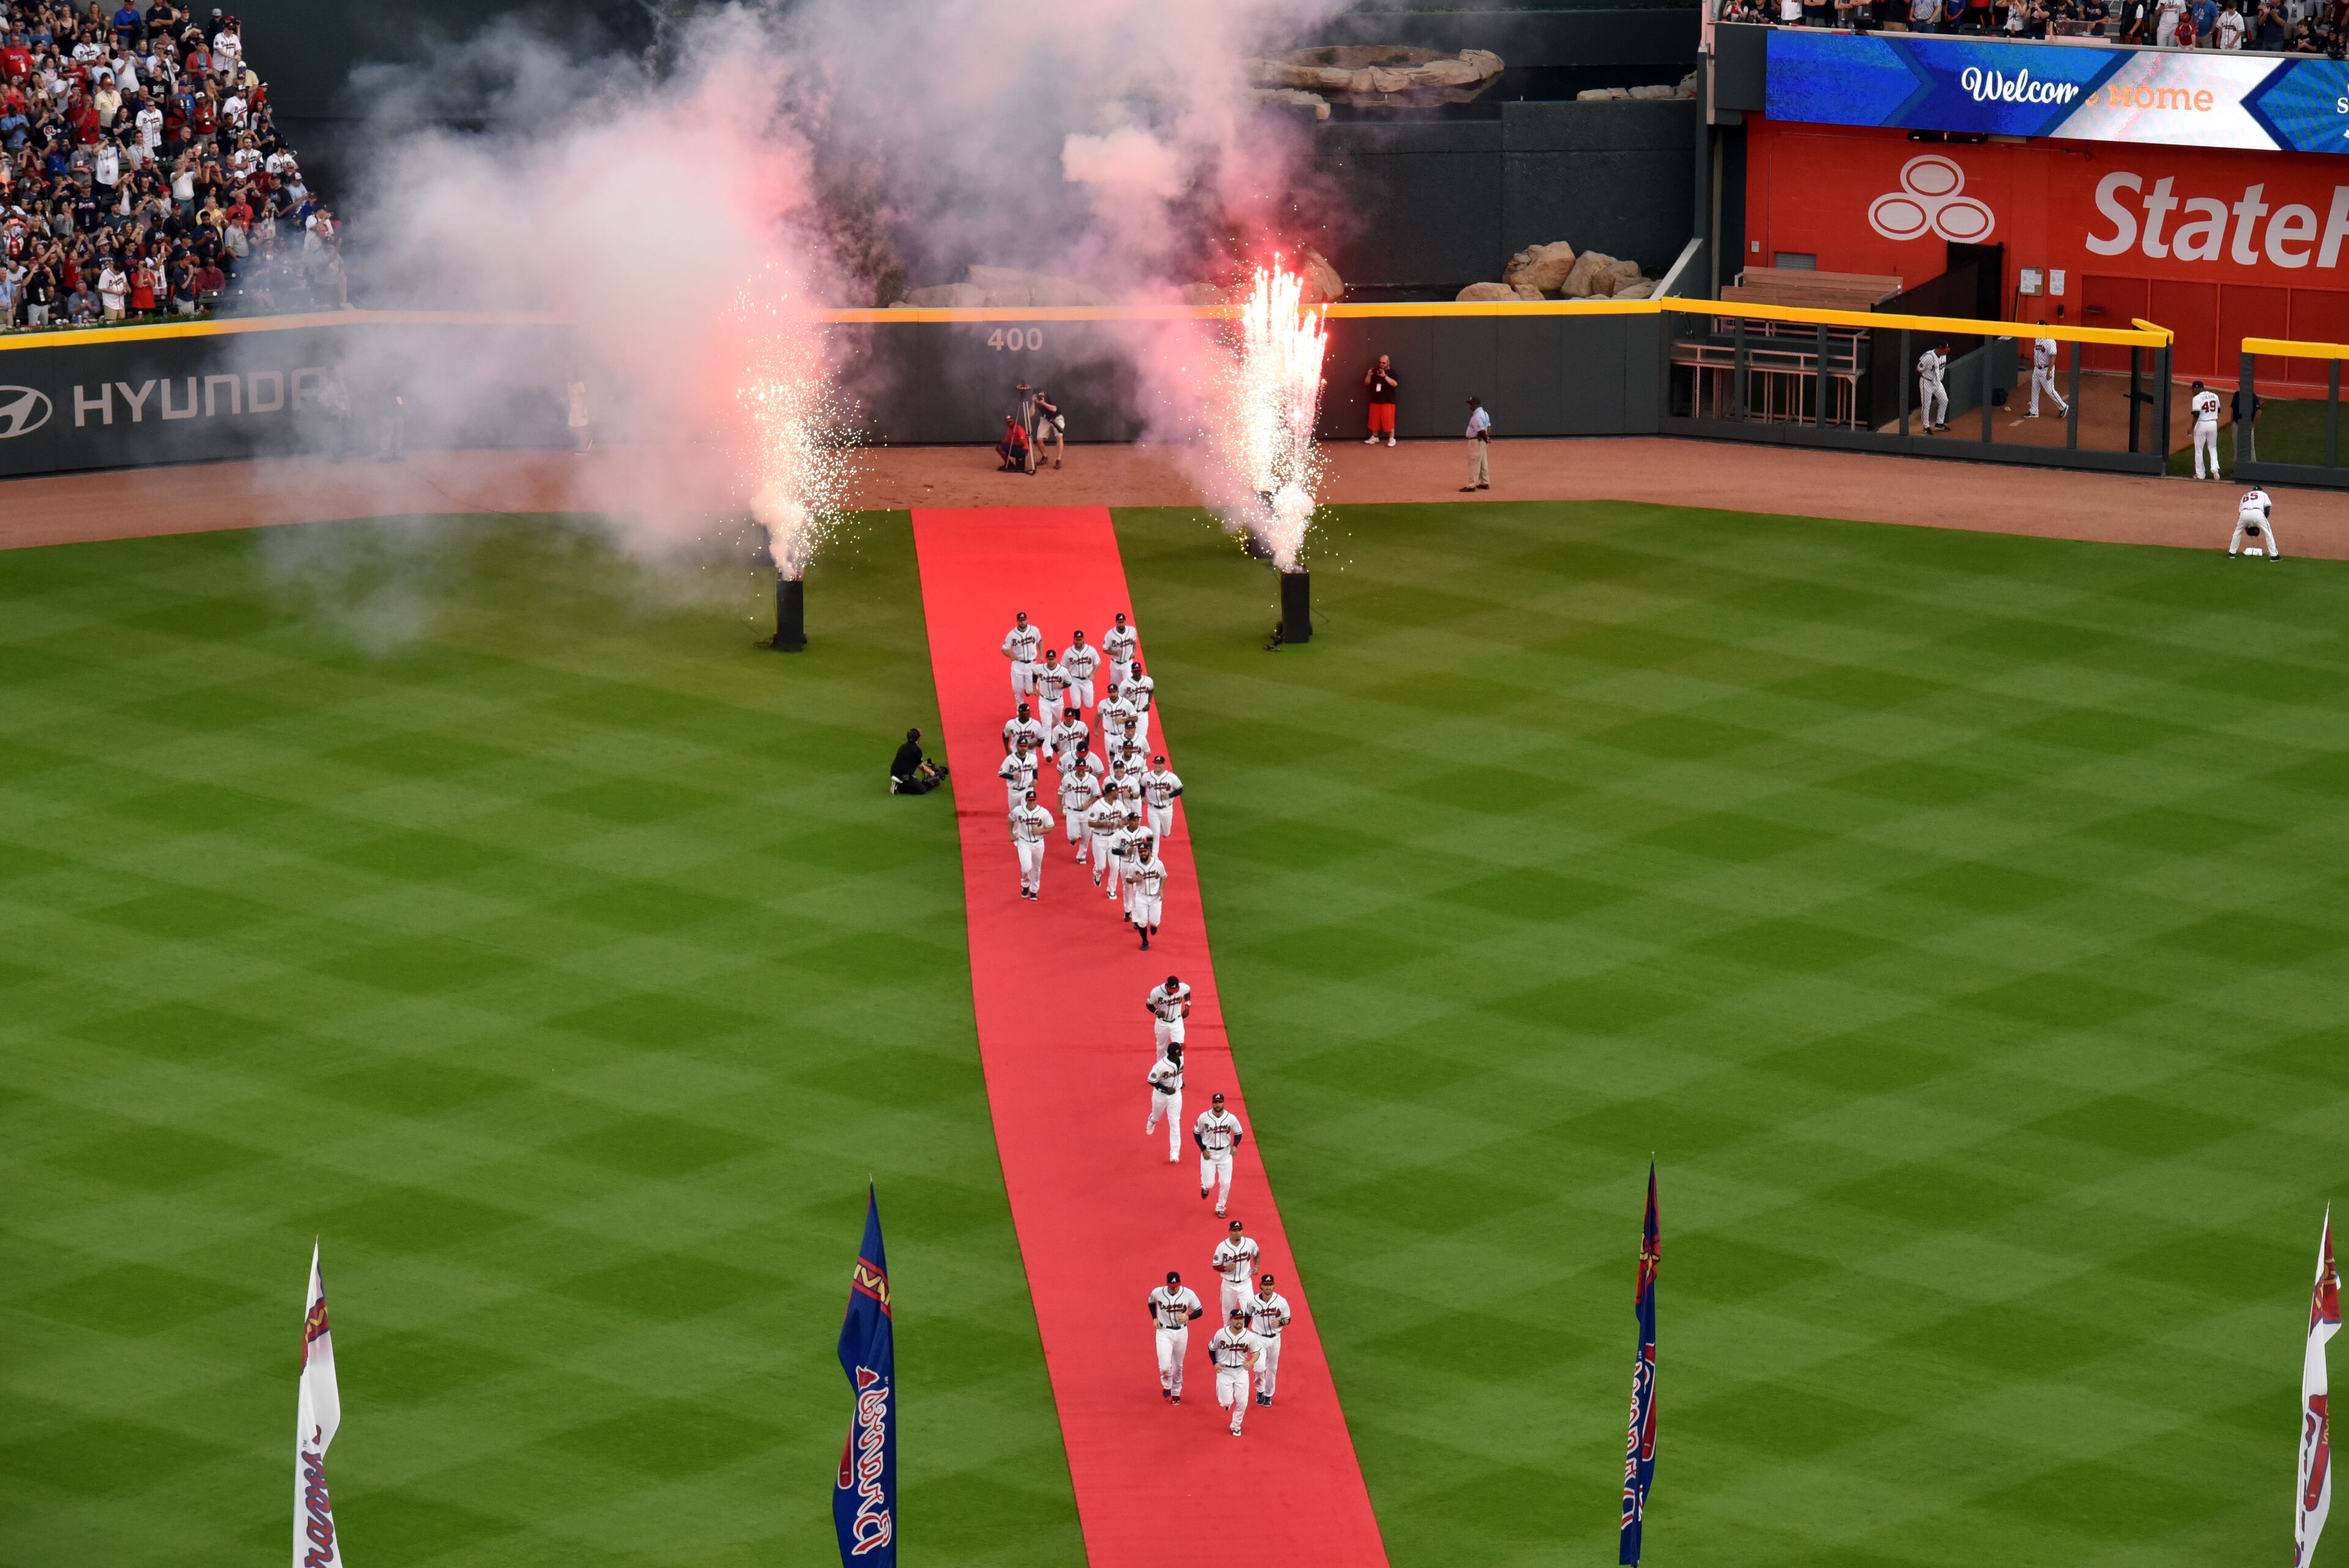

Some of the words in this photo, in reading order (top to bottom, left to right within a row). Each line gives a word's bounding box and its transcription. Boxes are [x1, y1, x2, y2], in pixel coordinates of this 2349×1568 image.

[2109, 84, 2214, 112] Home
[987, 328, 1043, 351] 400
[73, 366, 335, 427] HYUNDA
[2201, 400, 2216, 413] 49
[1204, 1123, 1231, 1134] Braves
[1222, 1250, 1250, 1263] Braves
[1157, 1301, 1184, 1312] Braves
[1219, 1340, 1246, 1350] Braves
